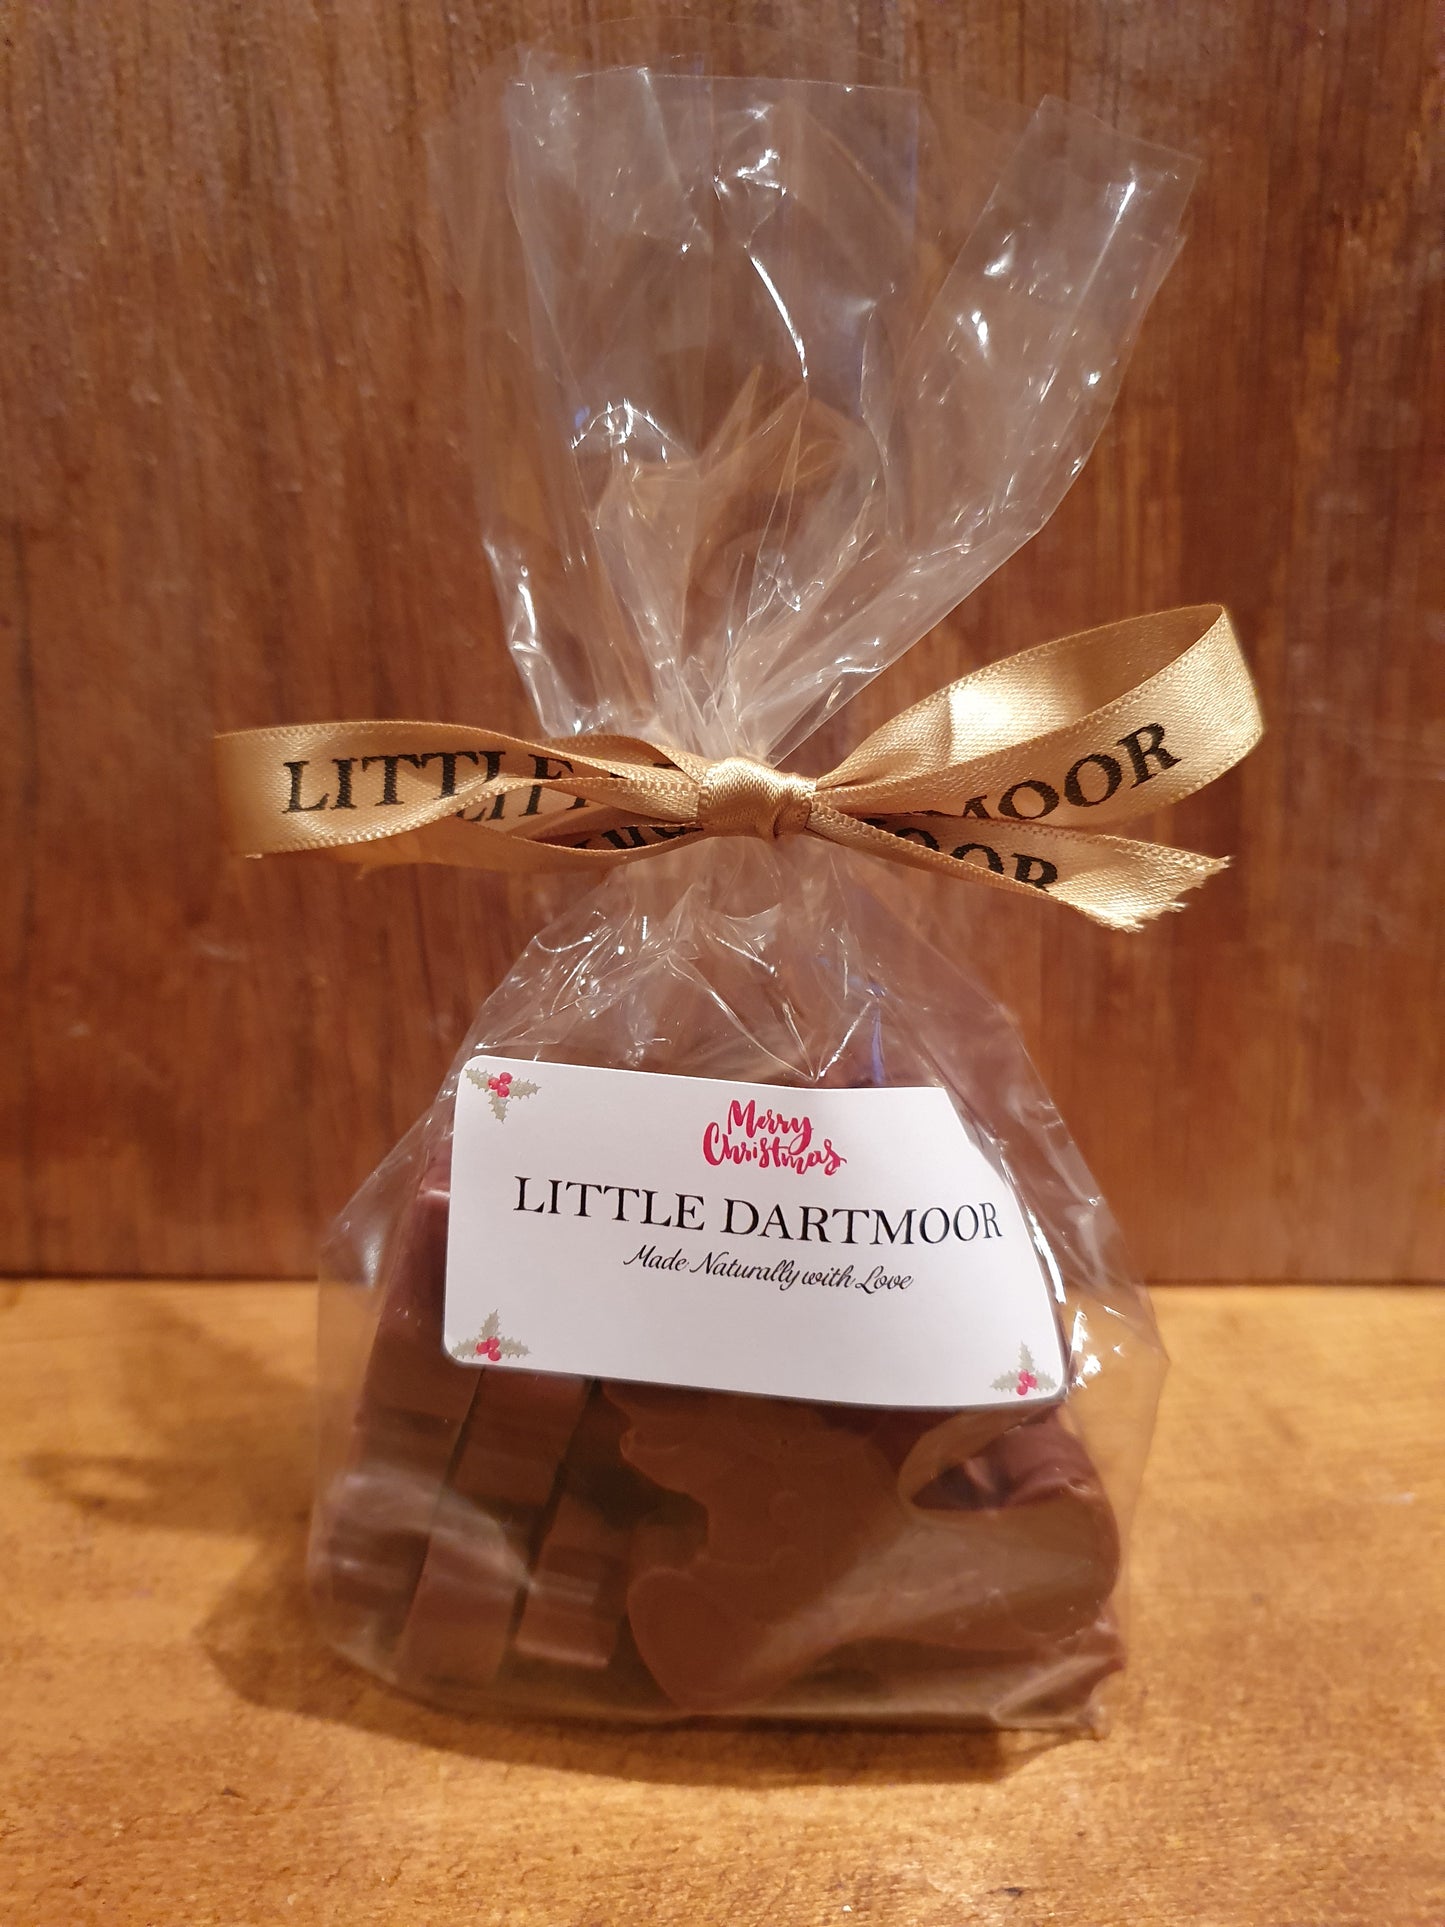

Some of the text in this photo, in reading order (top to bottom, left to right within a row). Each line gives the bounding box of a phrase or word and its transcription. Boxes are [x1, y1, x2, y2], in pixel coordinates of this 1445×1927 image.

[703, 1122, 847, 1176] Christmas
[727, 1099, 814, 1155] Merry
[513, 1176, 1002, 1246] LITTLE DARTMOOR
[623, 1244, 914, 1294] Made Naturally with Love
